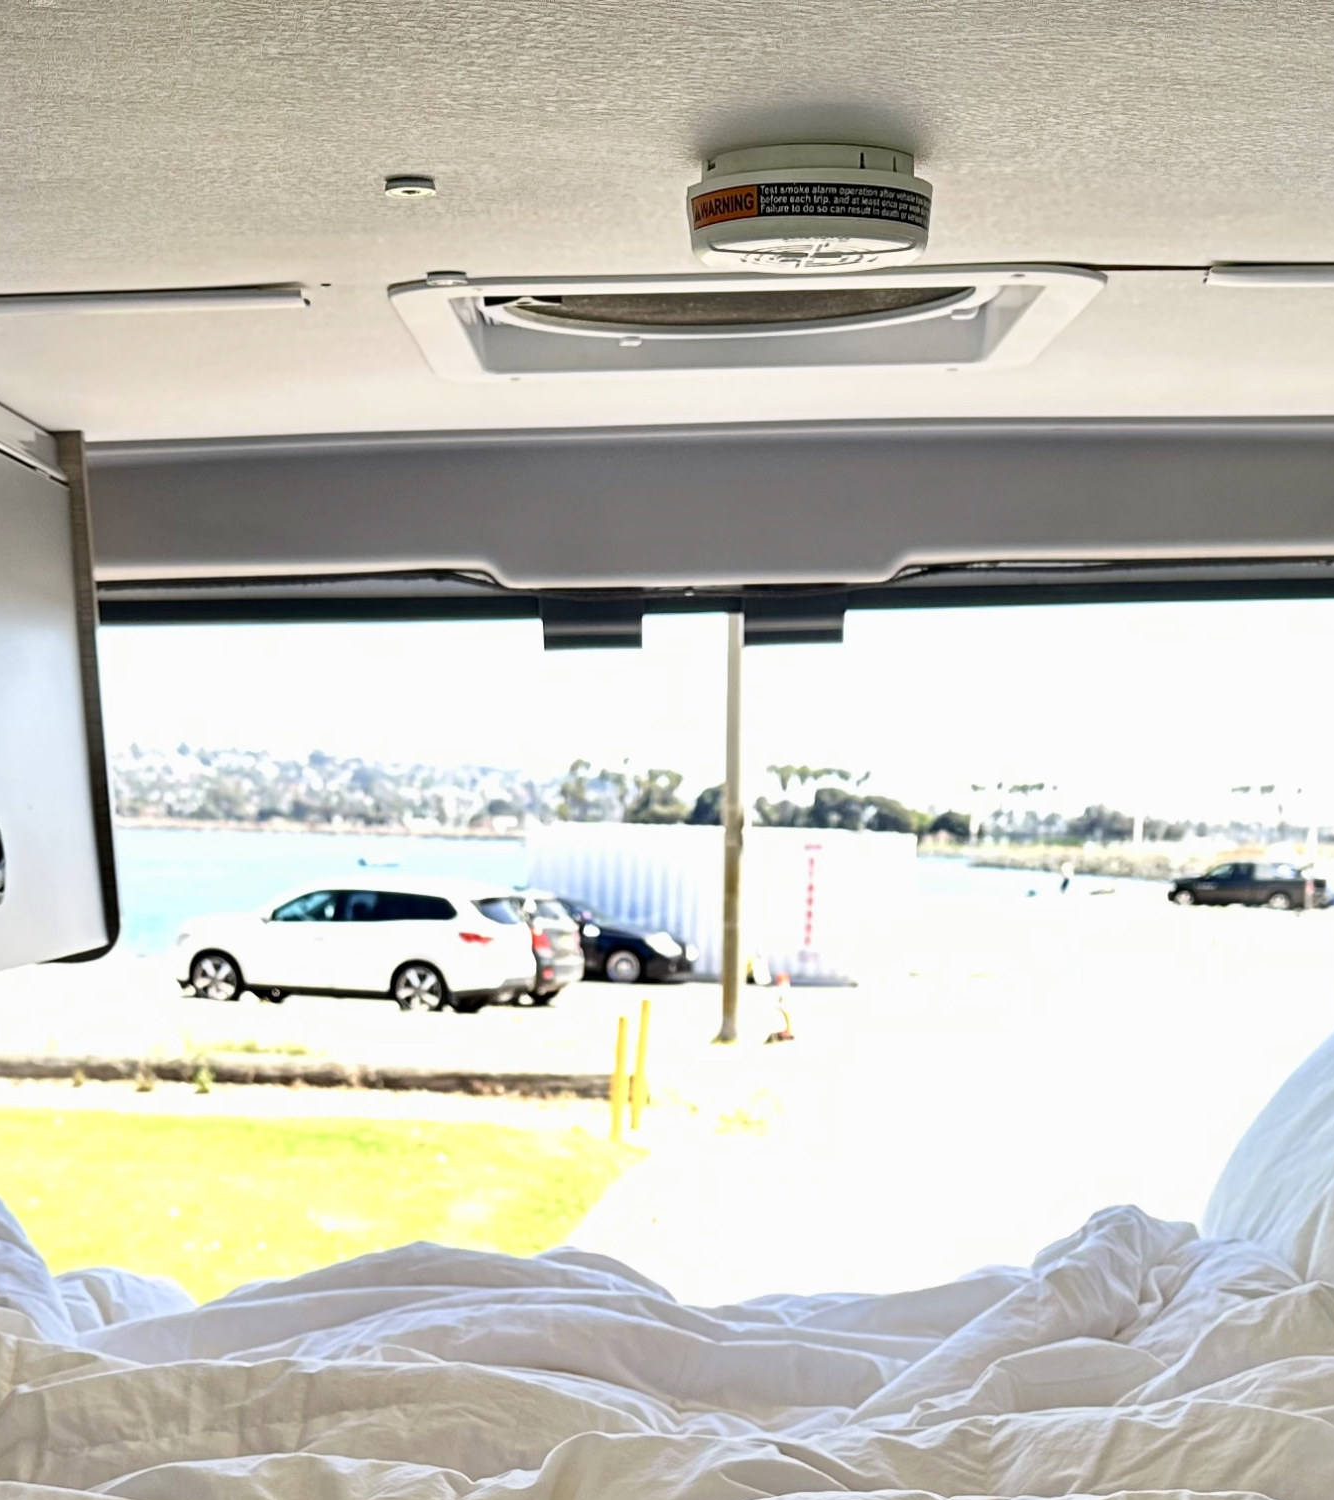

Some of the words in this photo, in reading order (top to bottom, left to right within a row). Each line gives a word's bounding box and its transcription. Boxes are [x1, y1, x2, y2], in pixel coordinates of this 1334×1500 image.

[760, 185, 778, 194] Test
[780, 185, 810, 194] smoke
[811, 185, 837, 194] alarm
[839, 186, 878, 197] operation
[700, 192, 754, 219] WARNING
[760, 195, 788, 204] before
[789, 194, 811, 203] each
[833, 195, 850, 205] and
[861, 196, 880, 207] least
[760, 204, 789, 213] Failure
[791, 204, 801, 213] to
[802, 204, 815, 213] do
[816, 205, 828, 213] so
[830, 205, 846, 213] can
[848, 206, 871, 215] result
